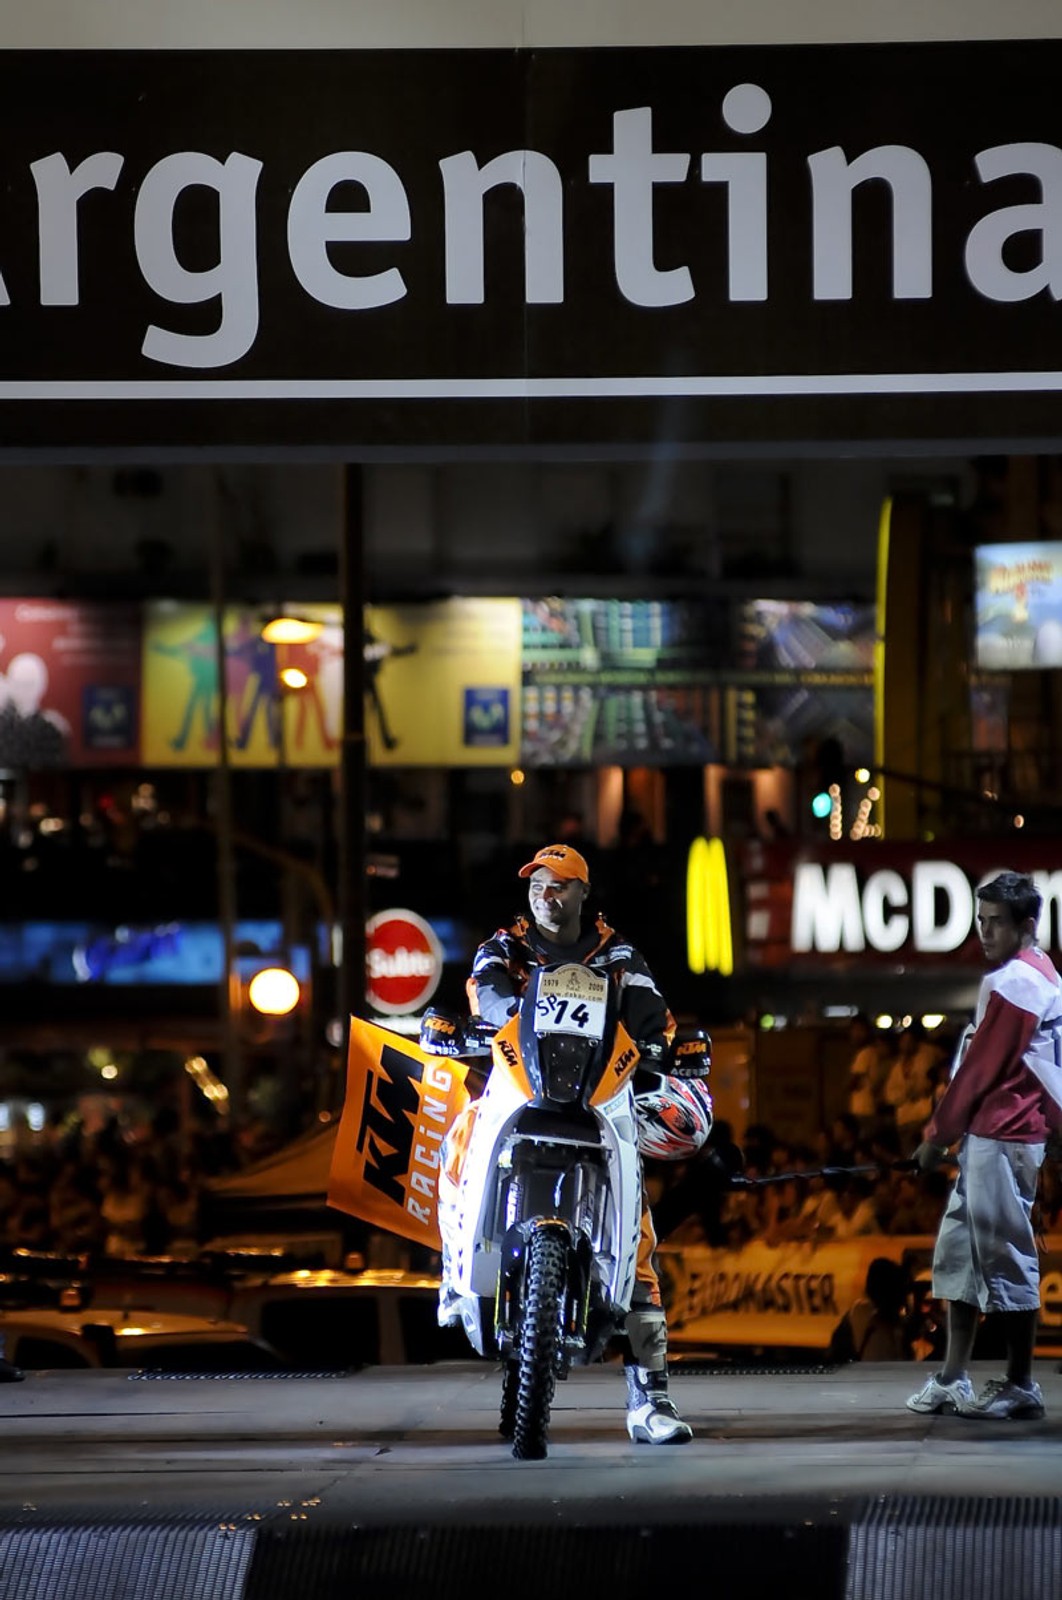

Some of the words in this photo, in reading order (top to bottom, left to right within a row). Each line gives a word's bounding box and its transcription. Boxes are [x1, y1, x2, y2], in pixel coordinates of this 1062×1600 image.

[0, 83, 1062, 368] rgentina
[791, 861, 1062, 953] McDn
[588, 982, 604, 993] 2009
[424, 1017, 456, 1035] KTM
[554, 1000, 589, 1028] 14
[497, 1040, 518, 1067] KTM
[614, 1048, 636, 1077] KTM
[676, 1041, 707, 1056] KTM
[355, 1043, 424, 1208] KTM
